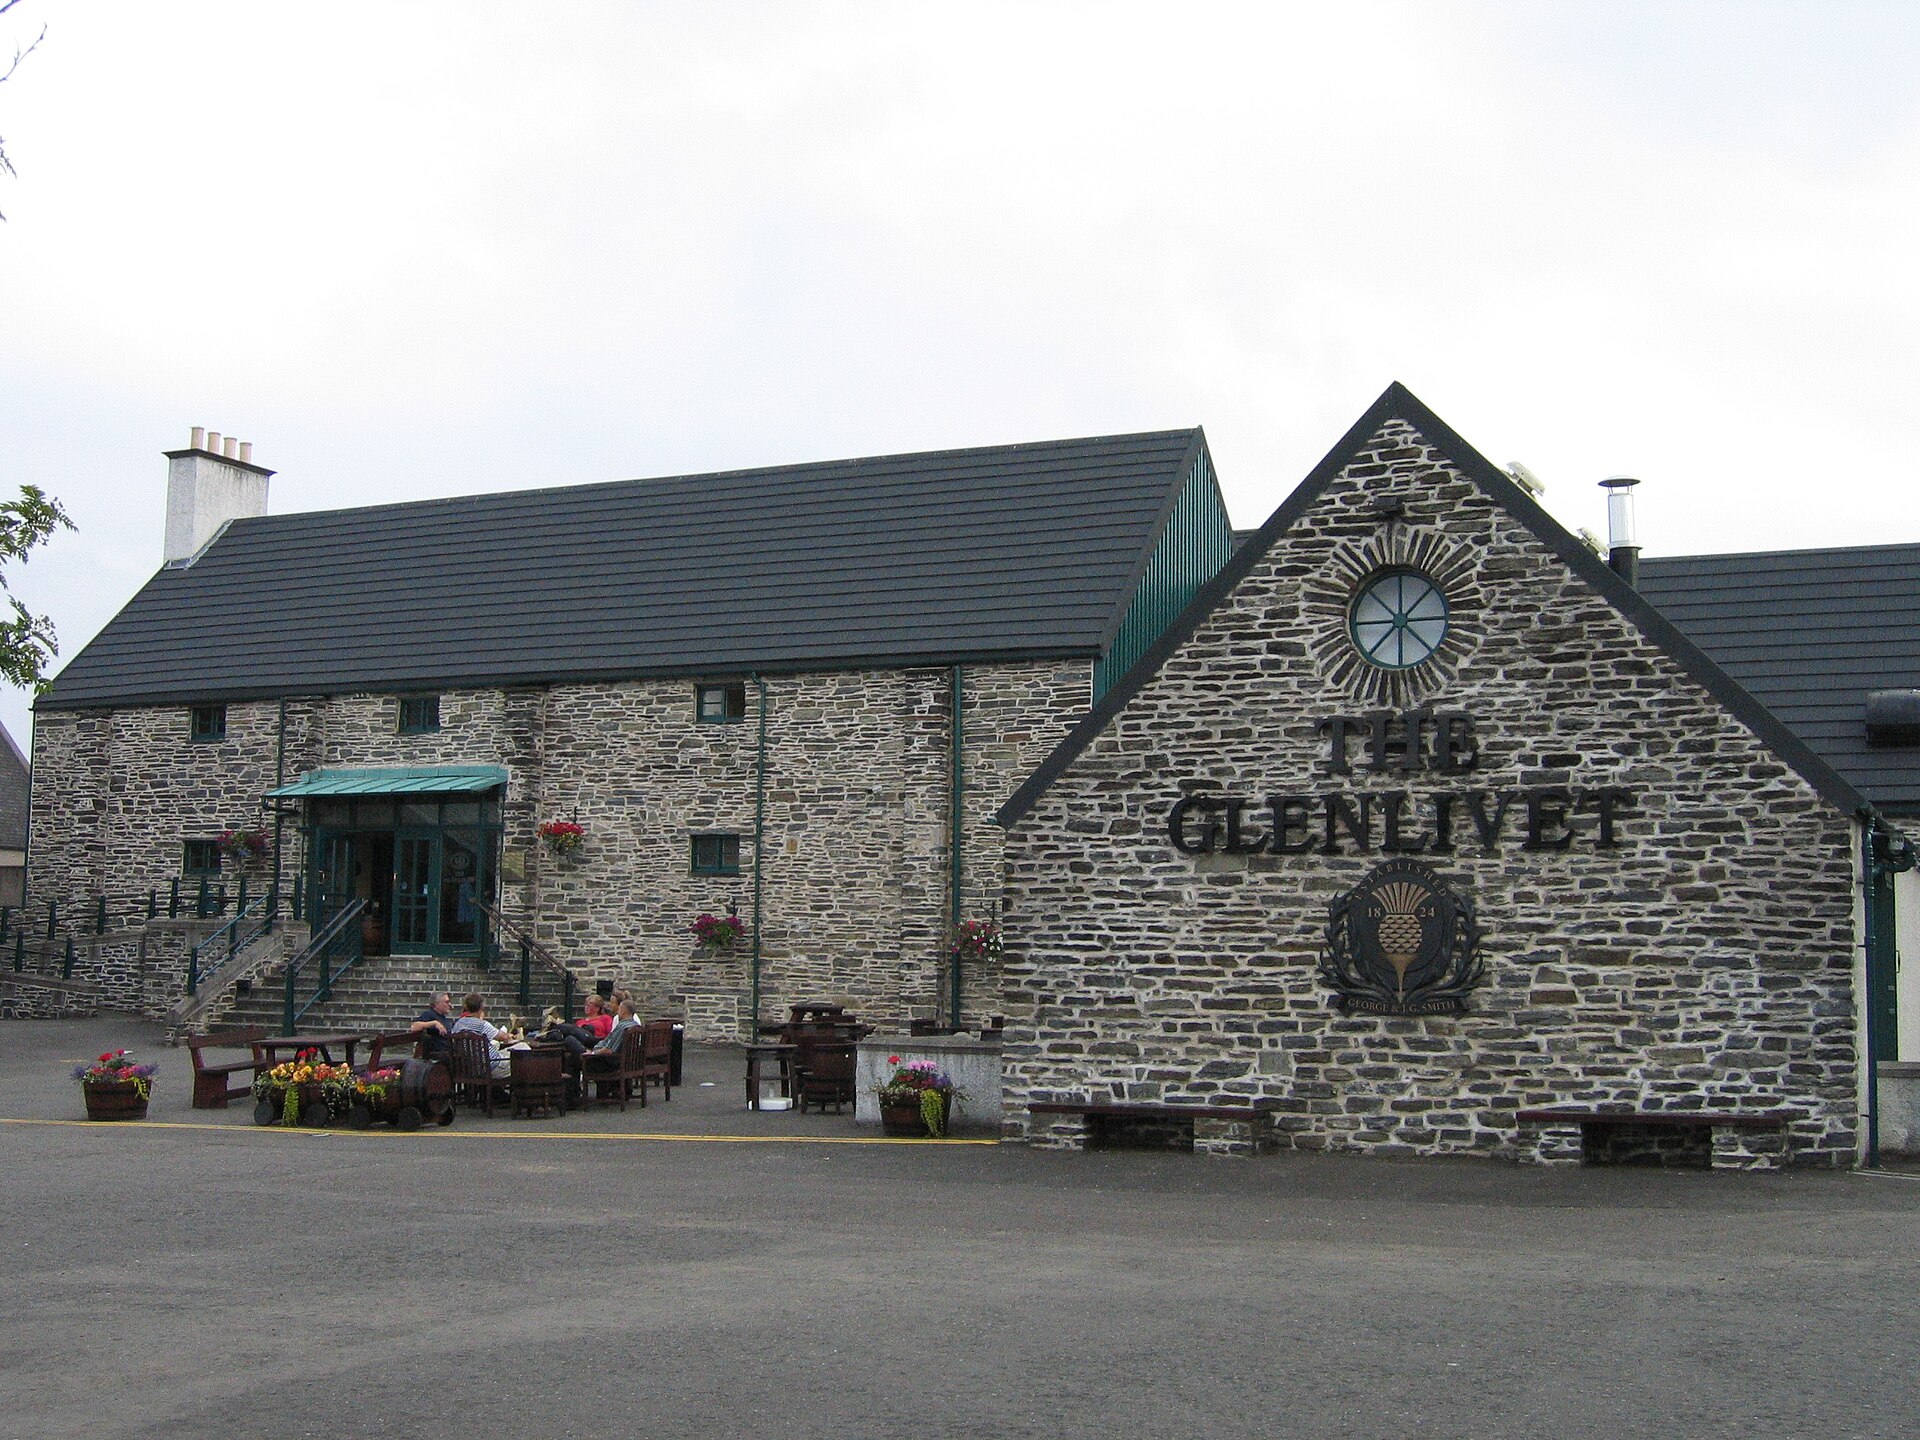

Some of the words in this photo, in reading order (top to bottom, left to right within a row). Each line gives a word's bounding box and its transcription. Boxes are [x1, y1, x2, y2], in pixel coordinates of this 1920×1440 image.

[1314, 711, 1479, 775] THE
[1167, 785, 1640, 855] GLENLIVET
[1355, 862, 1448, 901] ESTABLISHED
[1367, 907, 1381, 918] 18
[1419, 906, 1435, 918] 24
[1347, 998, 1388, 1012] GEORGE
[1422, 1000, 1456, 1012] SMITH
